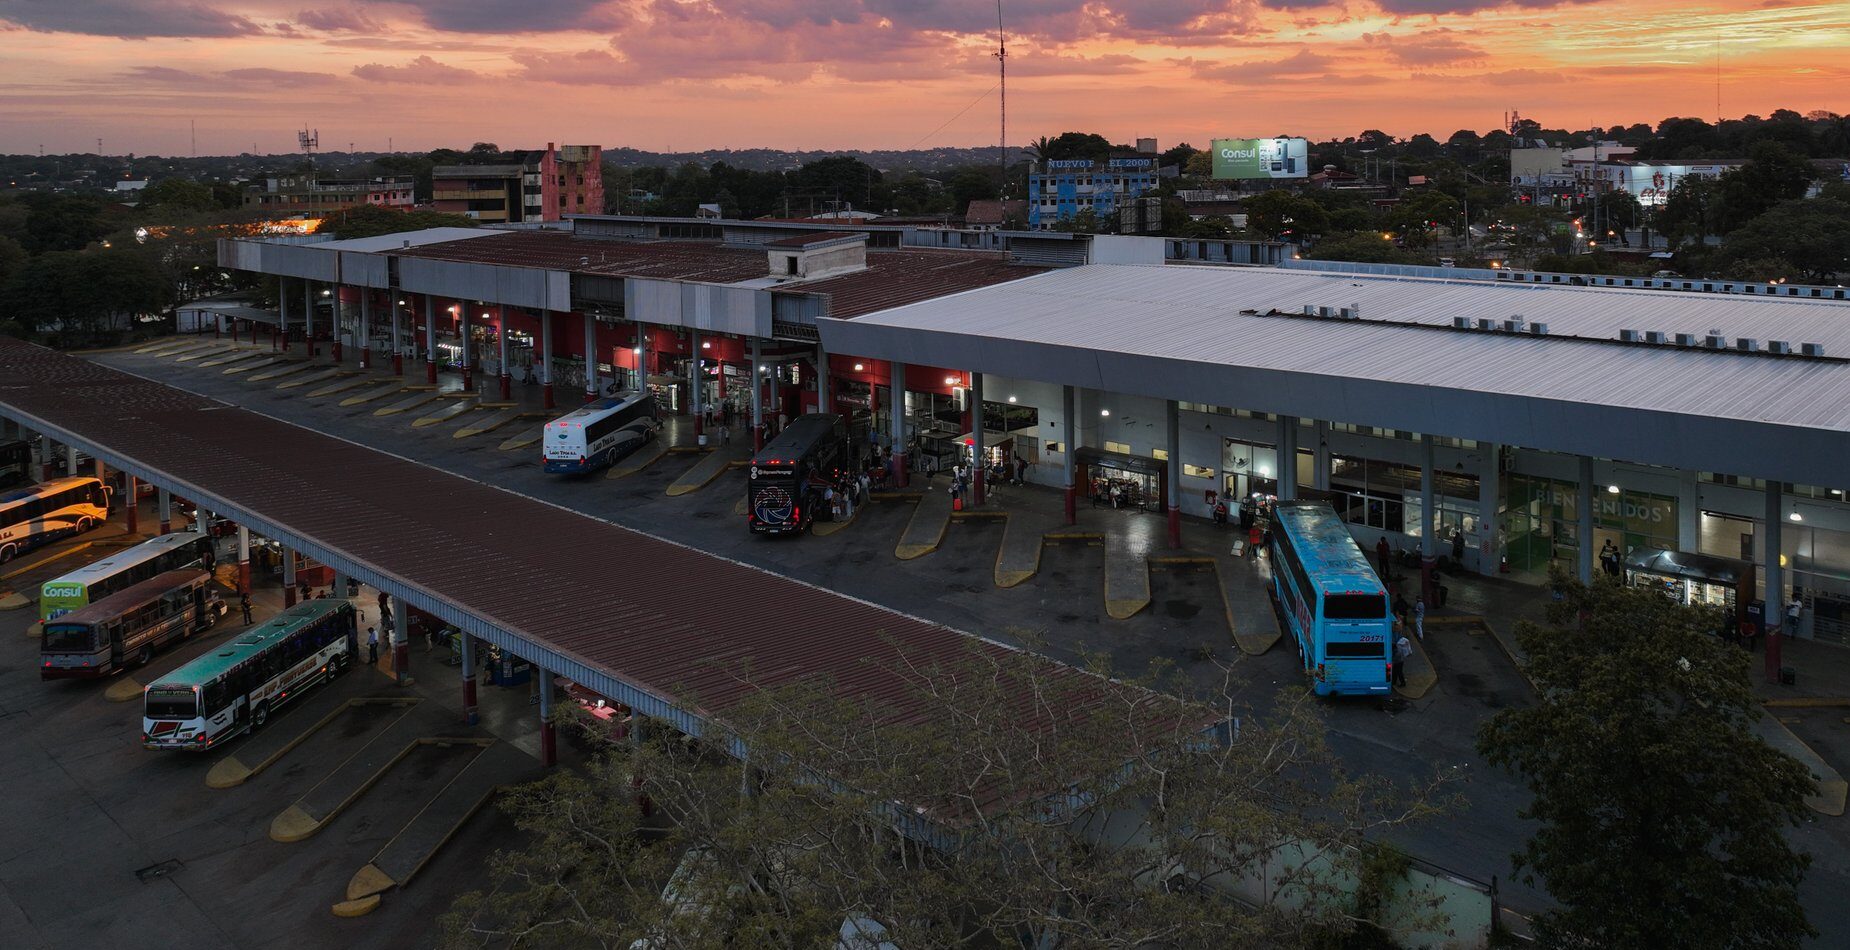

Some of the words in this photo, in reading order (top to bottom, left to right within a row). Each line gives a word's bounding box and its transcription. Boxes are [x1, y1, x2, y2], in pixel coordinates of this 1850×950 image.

[1222, 148, 1255, 158] Consul
[1048, 160, 1086, 168] NUEVO
[1126, 159, 1150, 167] 2000
[1536, 488, 1663, 523] BIENENIDOS
[43, 586, 82, 598] Consul
